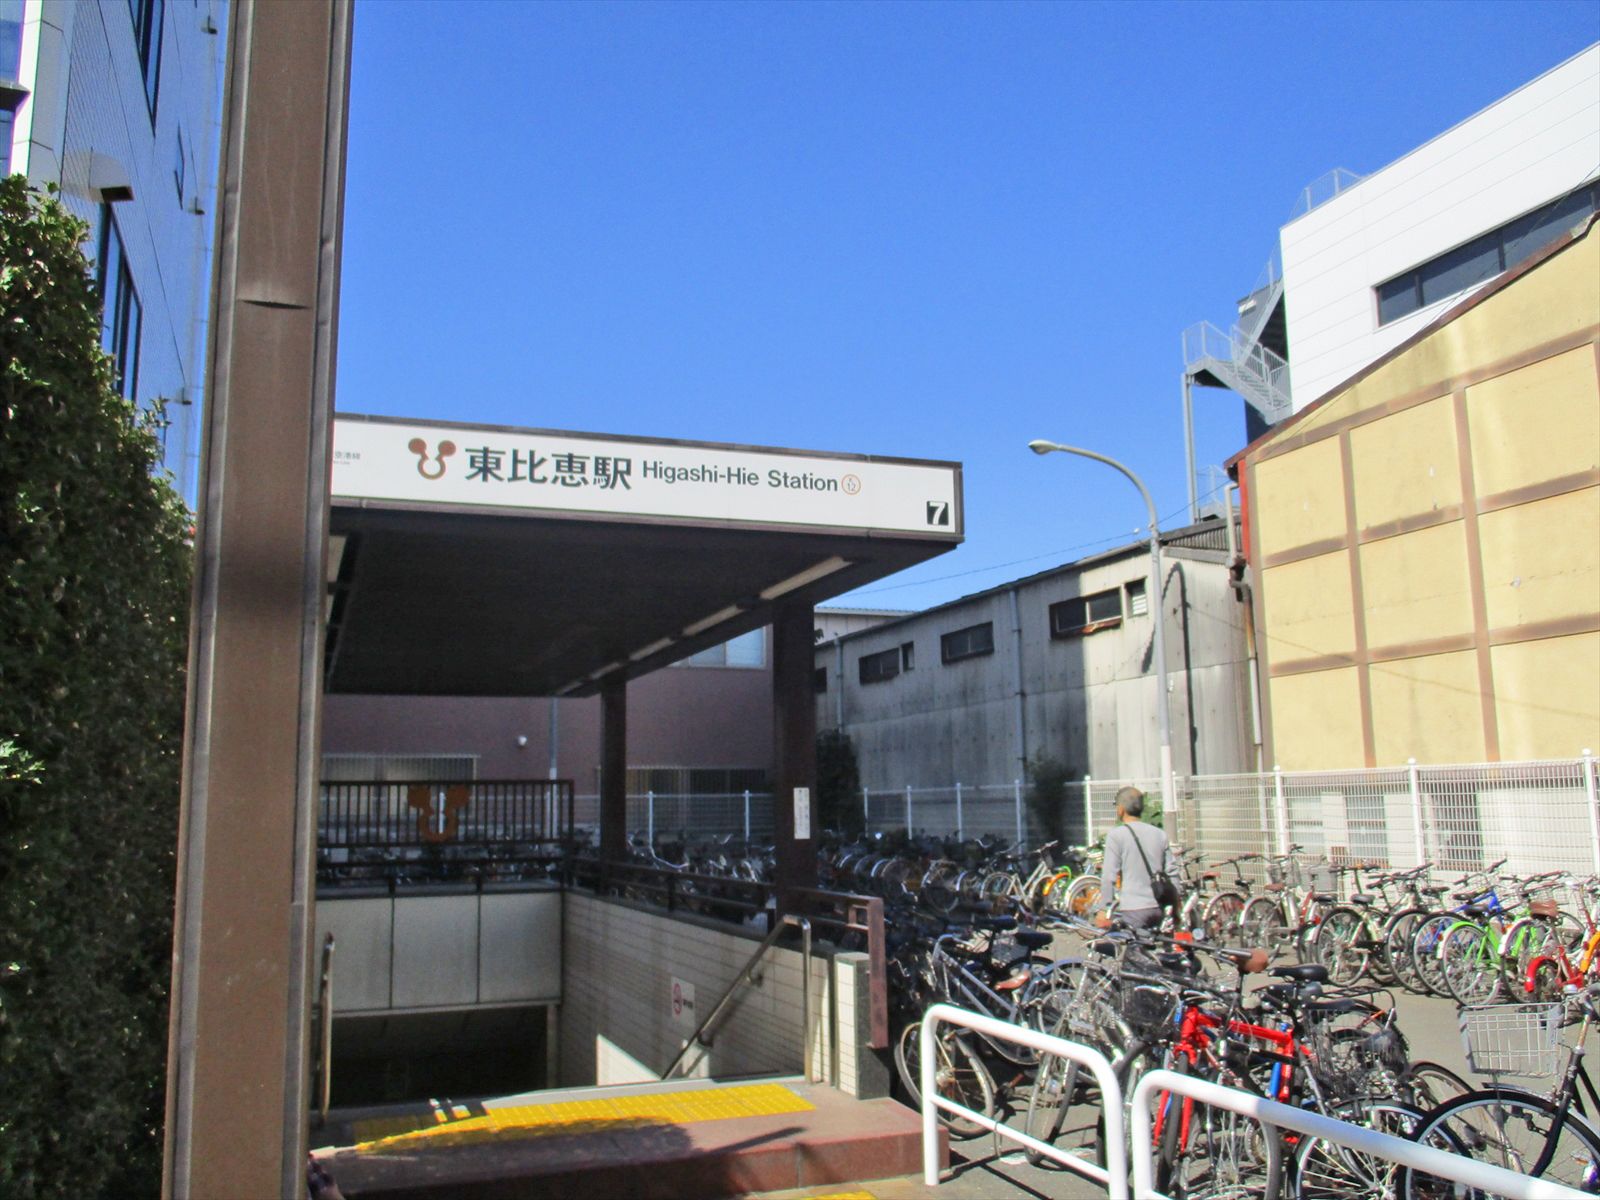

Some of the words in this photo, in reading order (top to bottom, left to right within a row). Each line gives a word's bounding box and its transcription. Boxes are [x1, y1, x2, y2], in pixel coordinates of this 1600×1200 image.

[465, 447, 632, 490] 東比恵駅
[643, 460, 760, 485] Higashi-Hie
[768, 469, 838, 492] Station
[929, 501, 946, 525] 7
